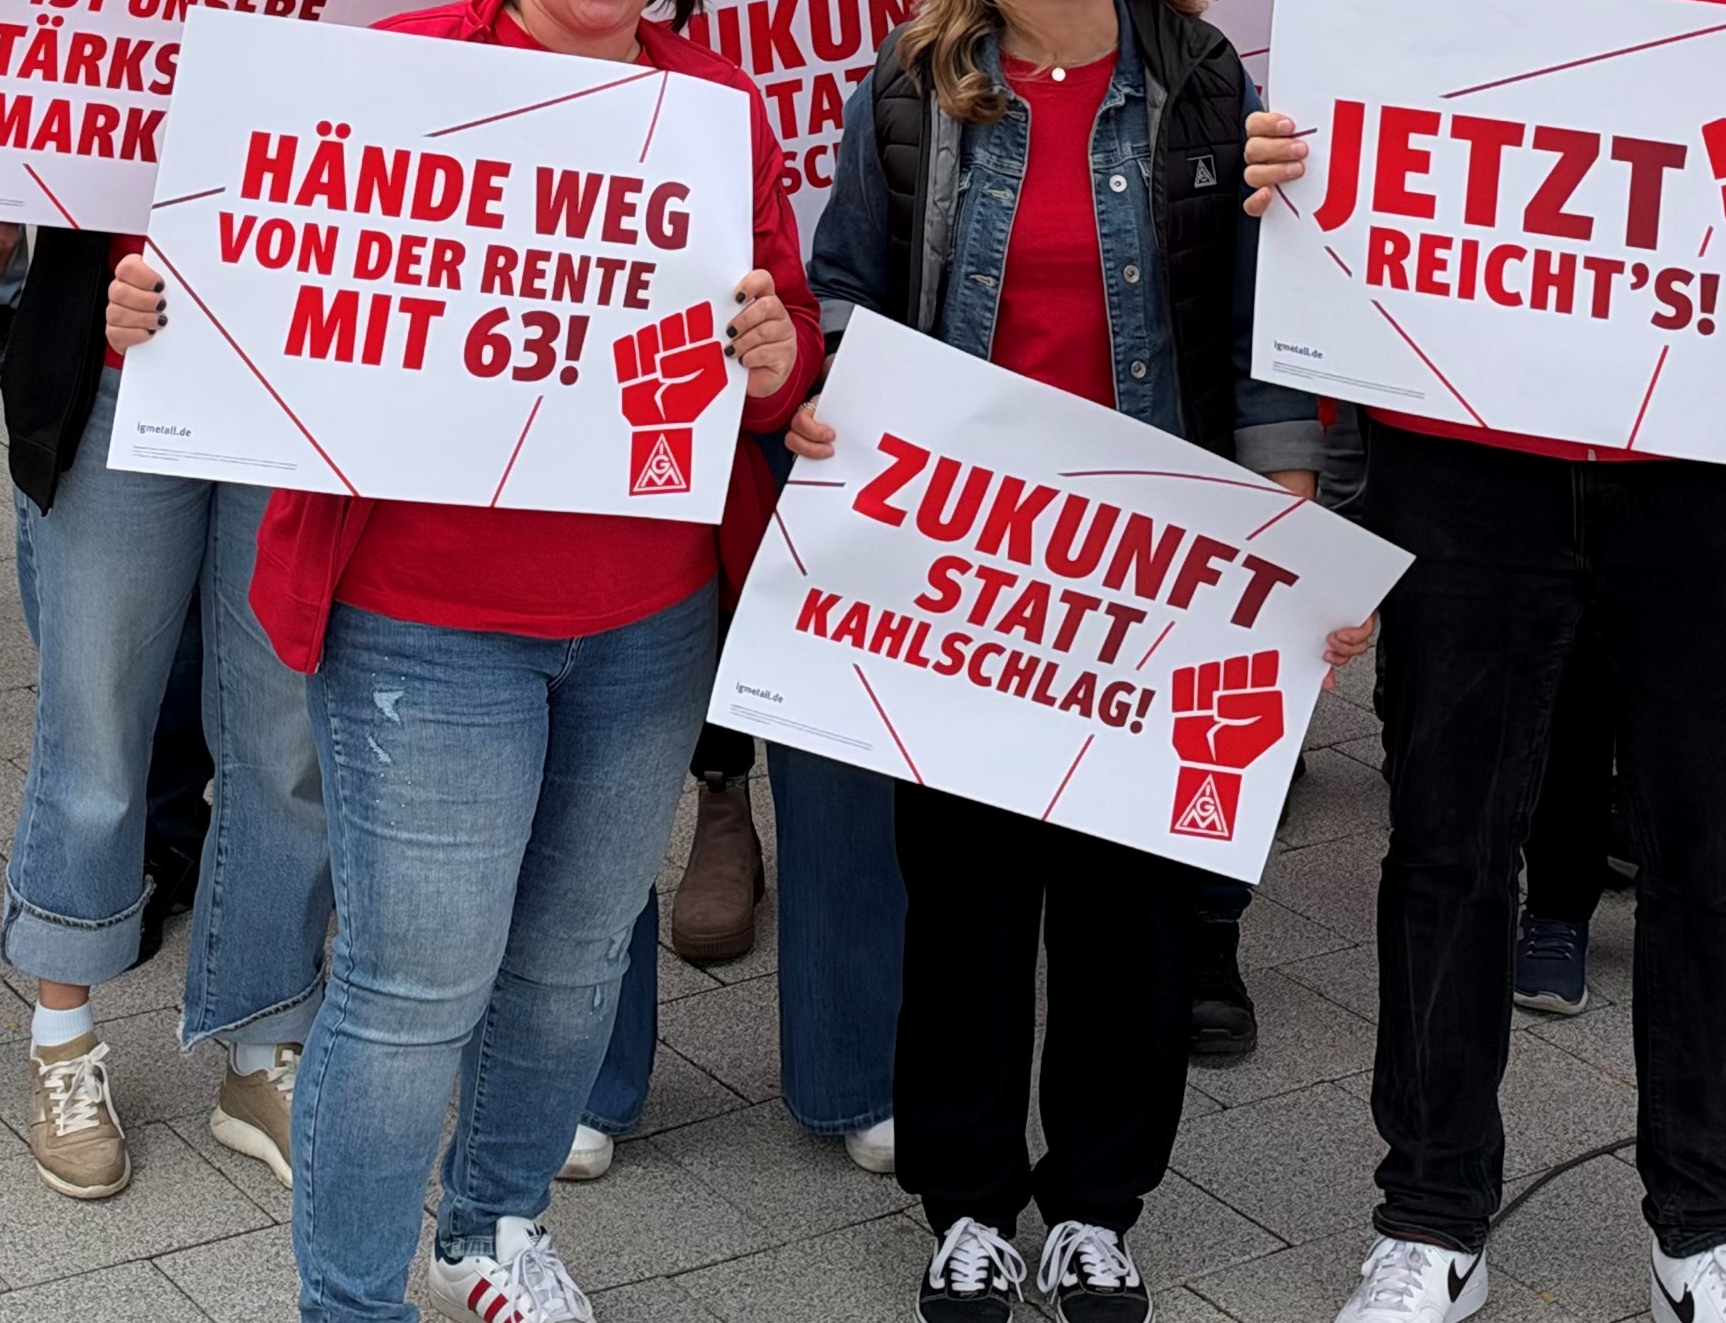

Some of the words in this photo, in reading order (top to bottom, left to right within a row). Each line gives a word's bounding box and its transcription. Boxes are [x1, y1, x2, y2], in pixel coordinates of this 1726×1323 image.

[242, 121, 510, 228] HÄNDE
[537, 168, 688, 249] WEG
[1314, 100, 1686, 249] JETZT
[220, 213, 338, 275] VON
[354, 230, 465, 289] DER
[482, 245, 654, 308] RENTE
[1367, 227, 1718, 334] REICHT'S!
[285, 286, 445, 369] MIT
[464, 308, 588, 384] 63!
[137, 421, 192, 438] igmetall.de
[634, 434, 691, 493] IGM
[853, 434, 1297, 627] ZUKUNFT
[797, 581, 1155, 732] KAHLSCHLAG!
[915, 555, 1148, 665] STATT
[735, 682, 785, 704] igmetall.de
[1174, 774, 1232, 837] IGM
